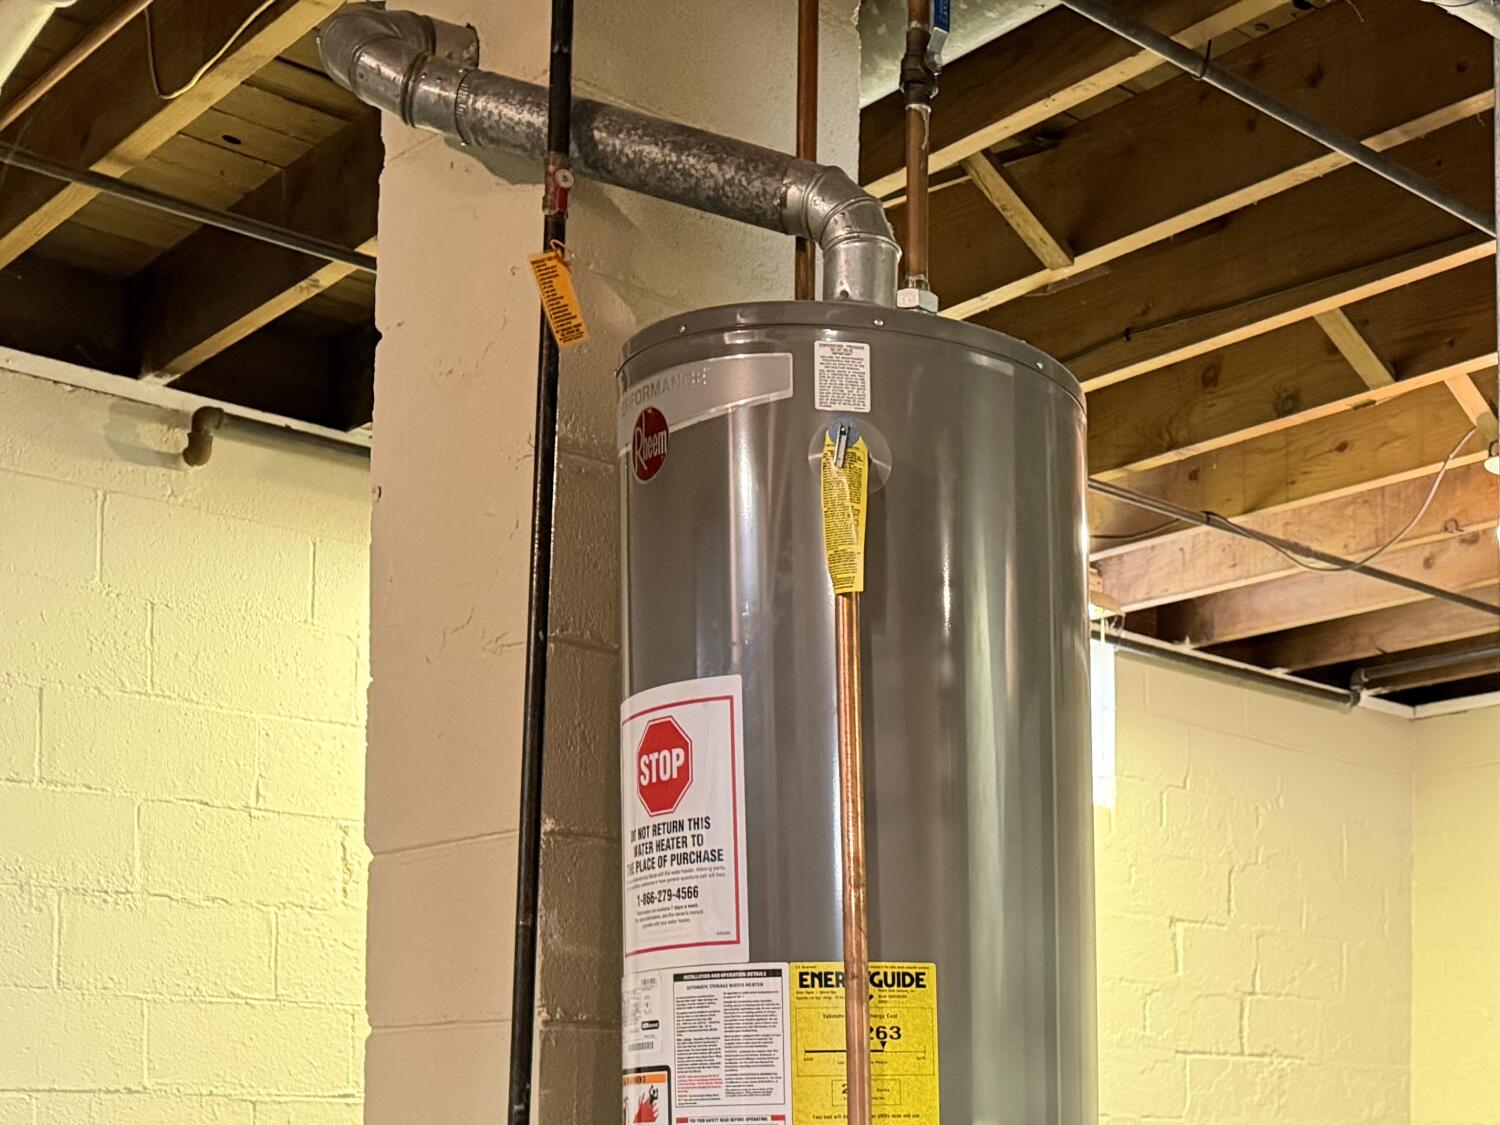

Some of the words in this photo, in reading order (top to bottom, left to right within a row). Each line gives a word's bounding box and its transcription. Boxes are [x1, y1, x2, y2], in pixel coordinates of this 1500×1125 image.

[634, 408, 667, 473] Rheem
[640, 747, 684, 786] STOP
[638, 825, 650, 840] NOT
[652, 819, 684, 837] RETURN
[688, 816, 711, 830] THIS
[656, 836, 688, 852] HEATER
[690, 834, 704, 847] TO
[636, 856, 655, 873] PLACE
[658, 854, 668, 868] OF
[670, 848, 724, 866] PURCHASE
[637, 886, 698, 907] 1-866-279-4566
[799, 972, 926, 988] ENERGUIDE
